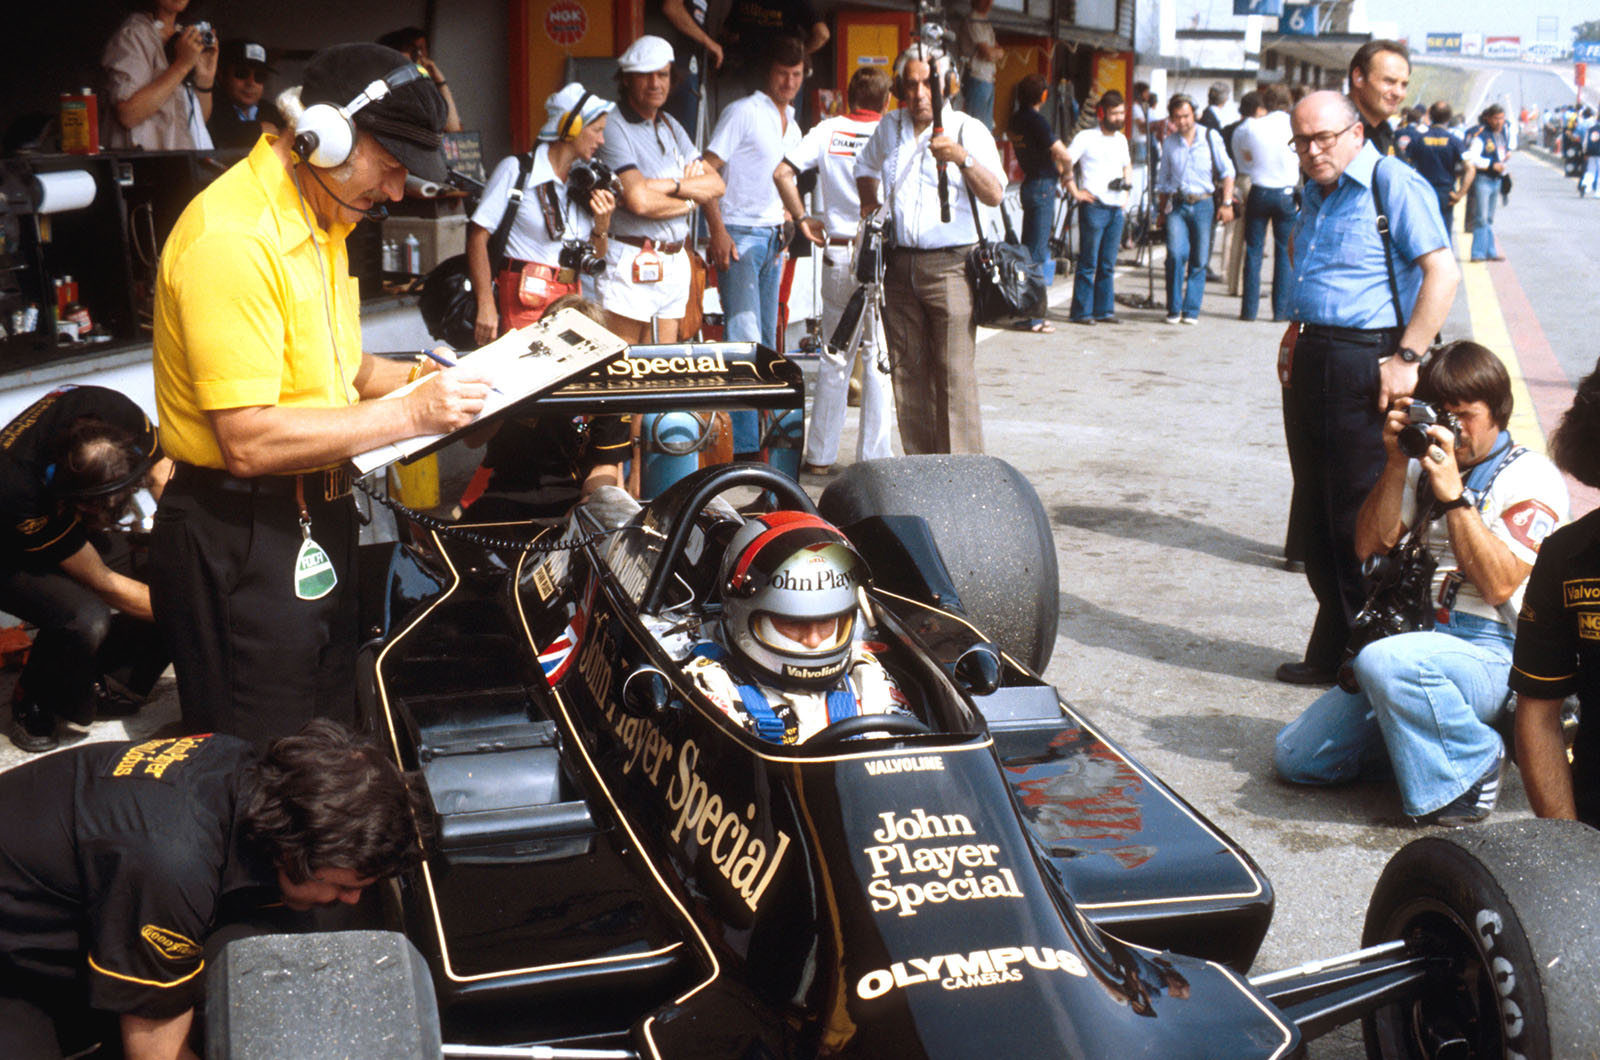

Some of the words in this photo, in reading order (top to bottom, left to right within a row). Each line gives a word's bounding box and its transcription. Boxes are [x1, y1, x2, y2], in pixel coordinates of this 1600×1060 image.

[550, 10, 582, 23] NGK
[1289, 8, 1305, 31] 6
[607, 345, 729, 378] Special
[816, 568, 854, 591] Play
[786, 663, 842, 678] Valvoline
[864, 756, 945, 776] VALVOLINE
[666, 739, 791, 912] Special
[873, 808, 977, 843] John
[863, 843, 1000, 879] Player
[867, 868, 1025, 917] Special
[856, 946, 1089, 1001] OLYMPUS
[941, 968, 1024, 990] CAMERAS
